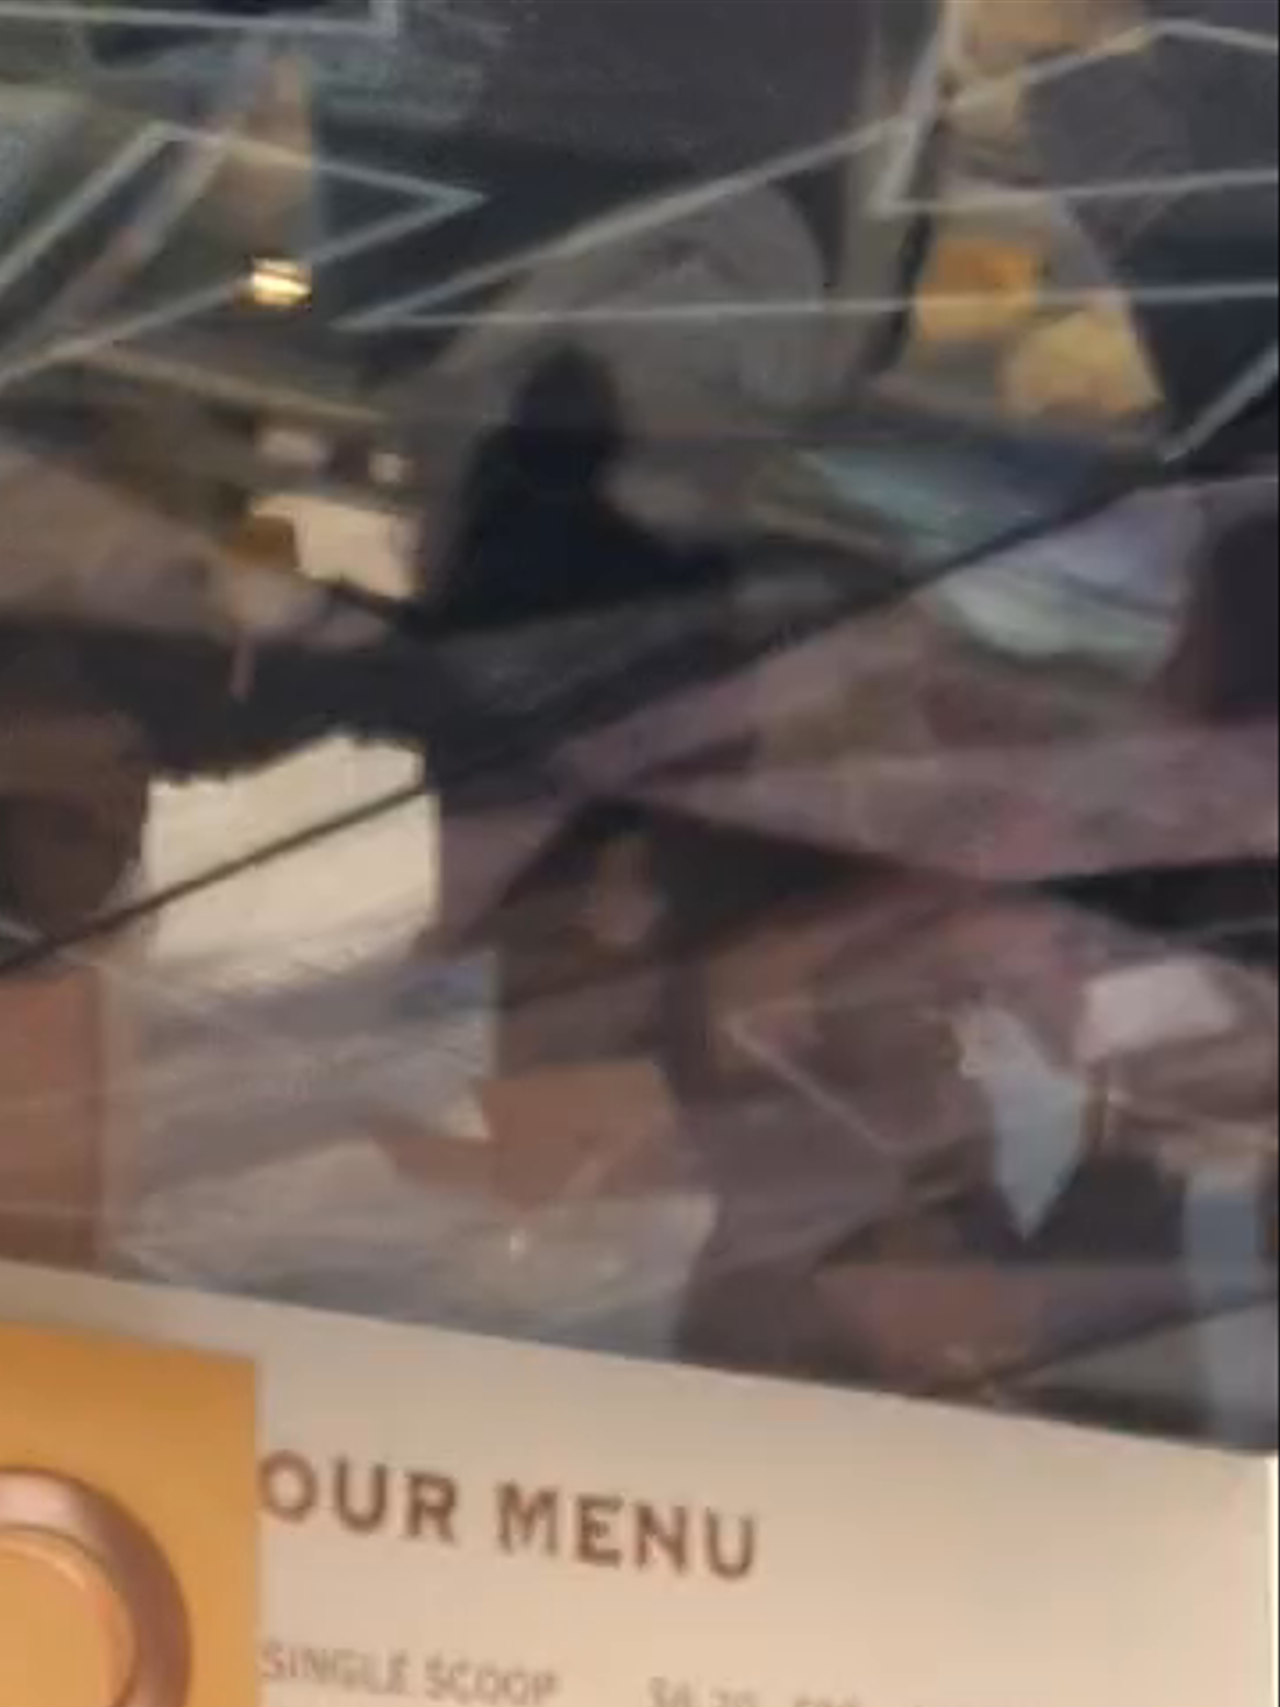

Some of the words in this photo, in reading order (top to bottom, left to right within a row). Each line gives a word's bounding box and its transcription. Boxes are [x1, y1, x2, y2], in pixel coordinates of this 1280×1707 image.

[258, 1449, 459, 1545] OUR
[494, 1479, 758, 1581] MENU
[261, 1640, 409, 1697] SINGLE
[424, 1651, 559, 1707] SCOOP
